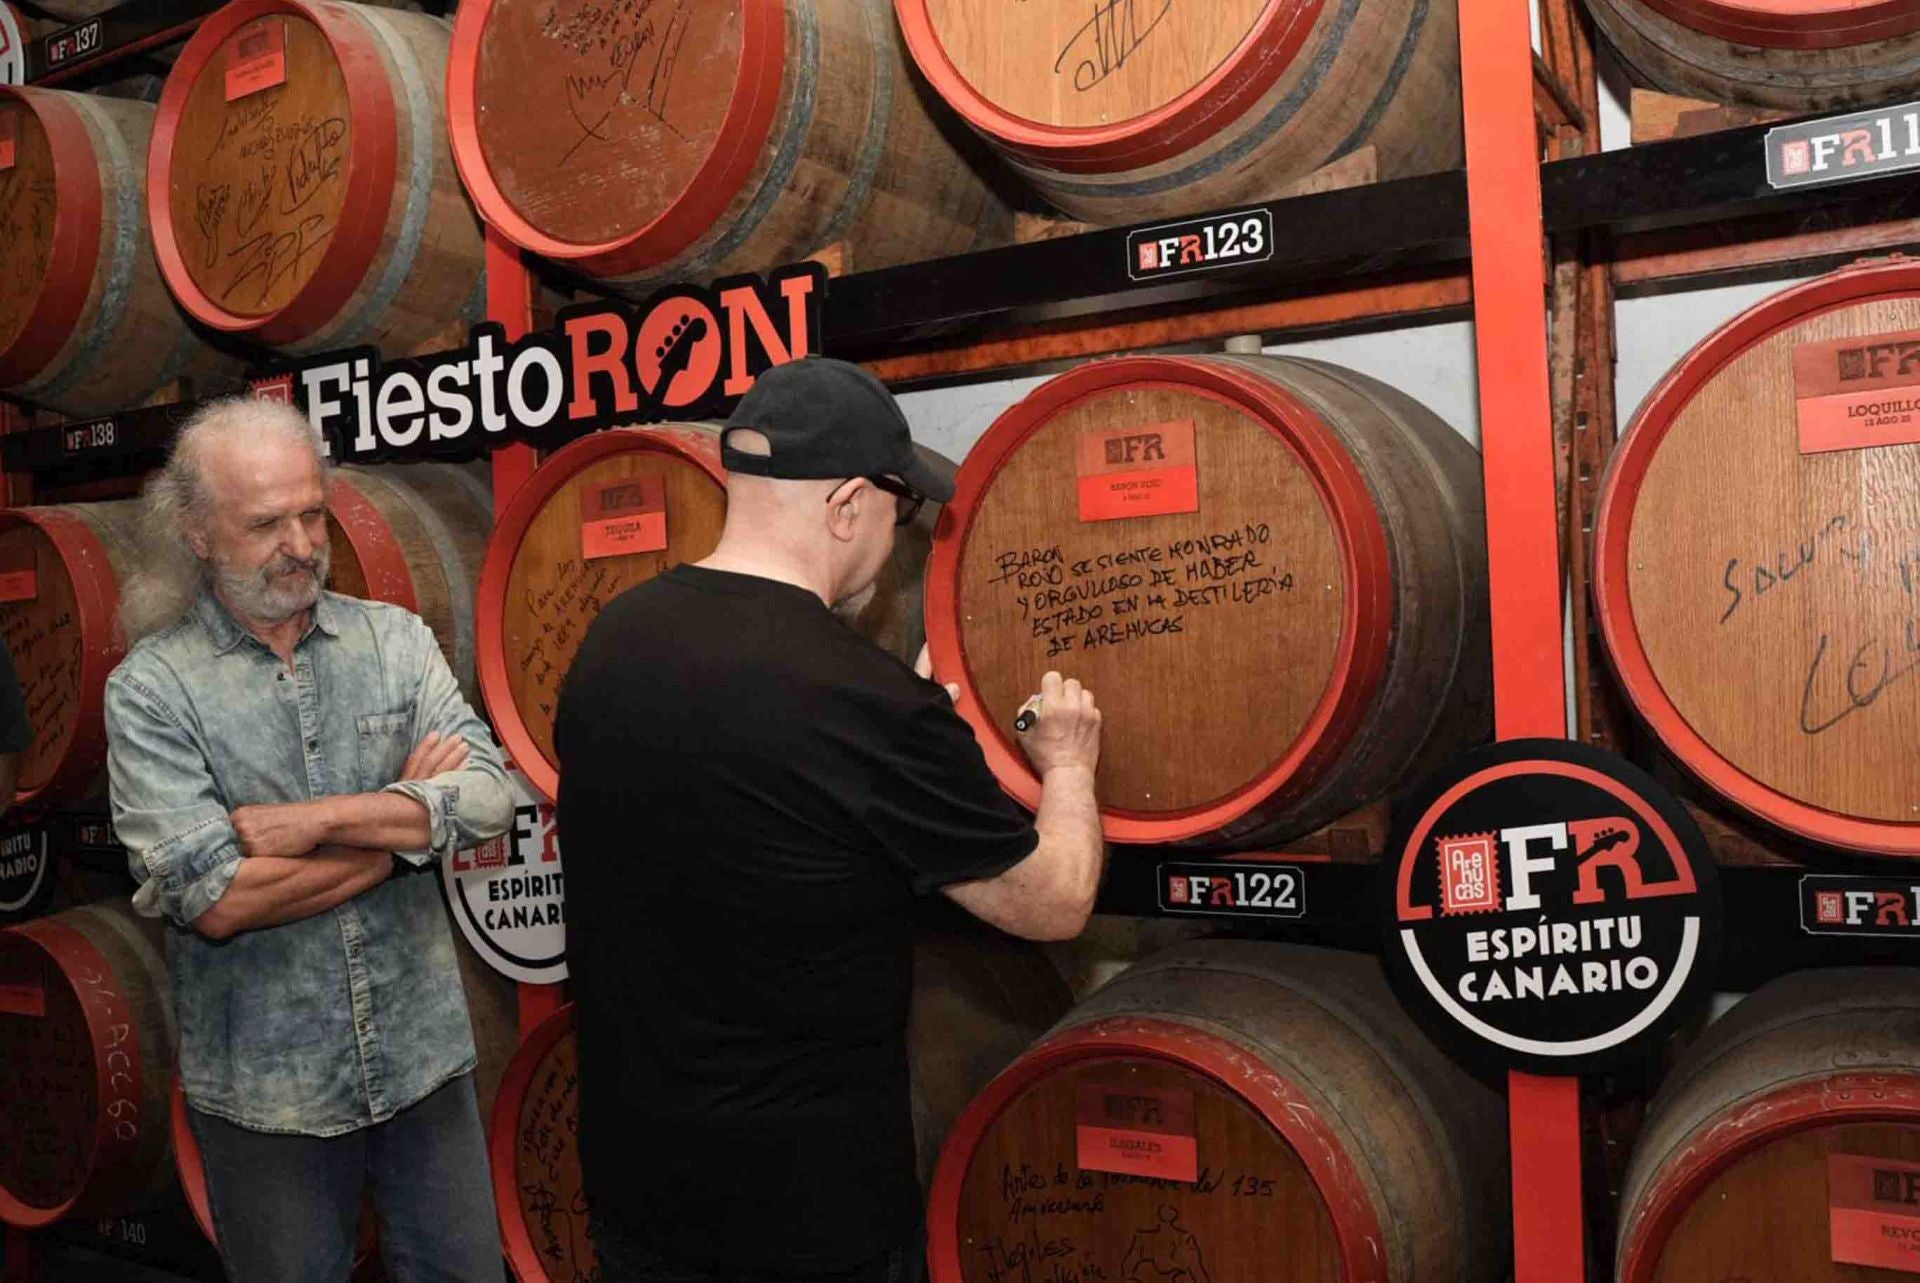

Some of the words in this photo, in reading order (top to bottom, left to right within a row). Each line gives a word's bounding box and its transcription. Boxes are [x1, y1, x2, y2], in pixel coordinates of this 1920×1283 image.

[1158, 218, 1264, 268] FR123
[1097, 547, 1162, 570] SIENTE
[1185, 550, 1263, 582] HABER
[1032, 604, 1103, 638] ESTADO
[1112, 595, 1139, 616] EN
[1189, 872, 1296, 909] FR122
[1466, 914, 1642, 963] ESPÍRITU
[1458, 956, 1659, 1003] CANARIO
